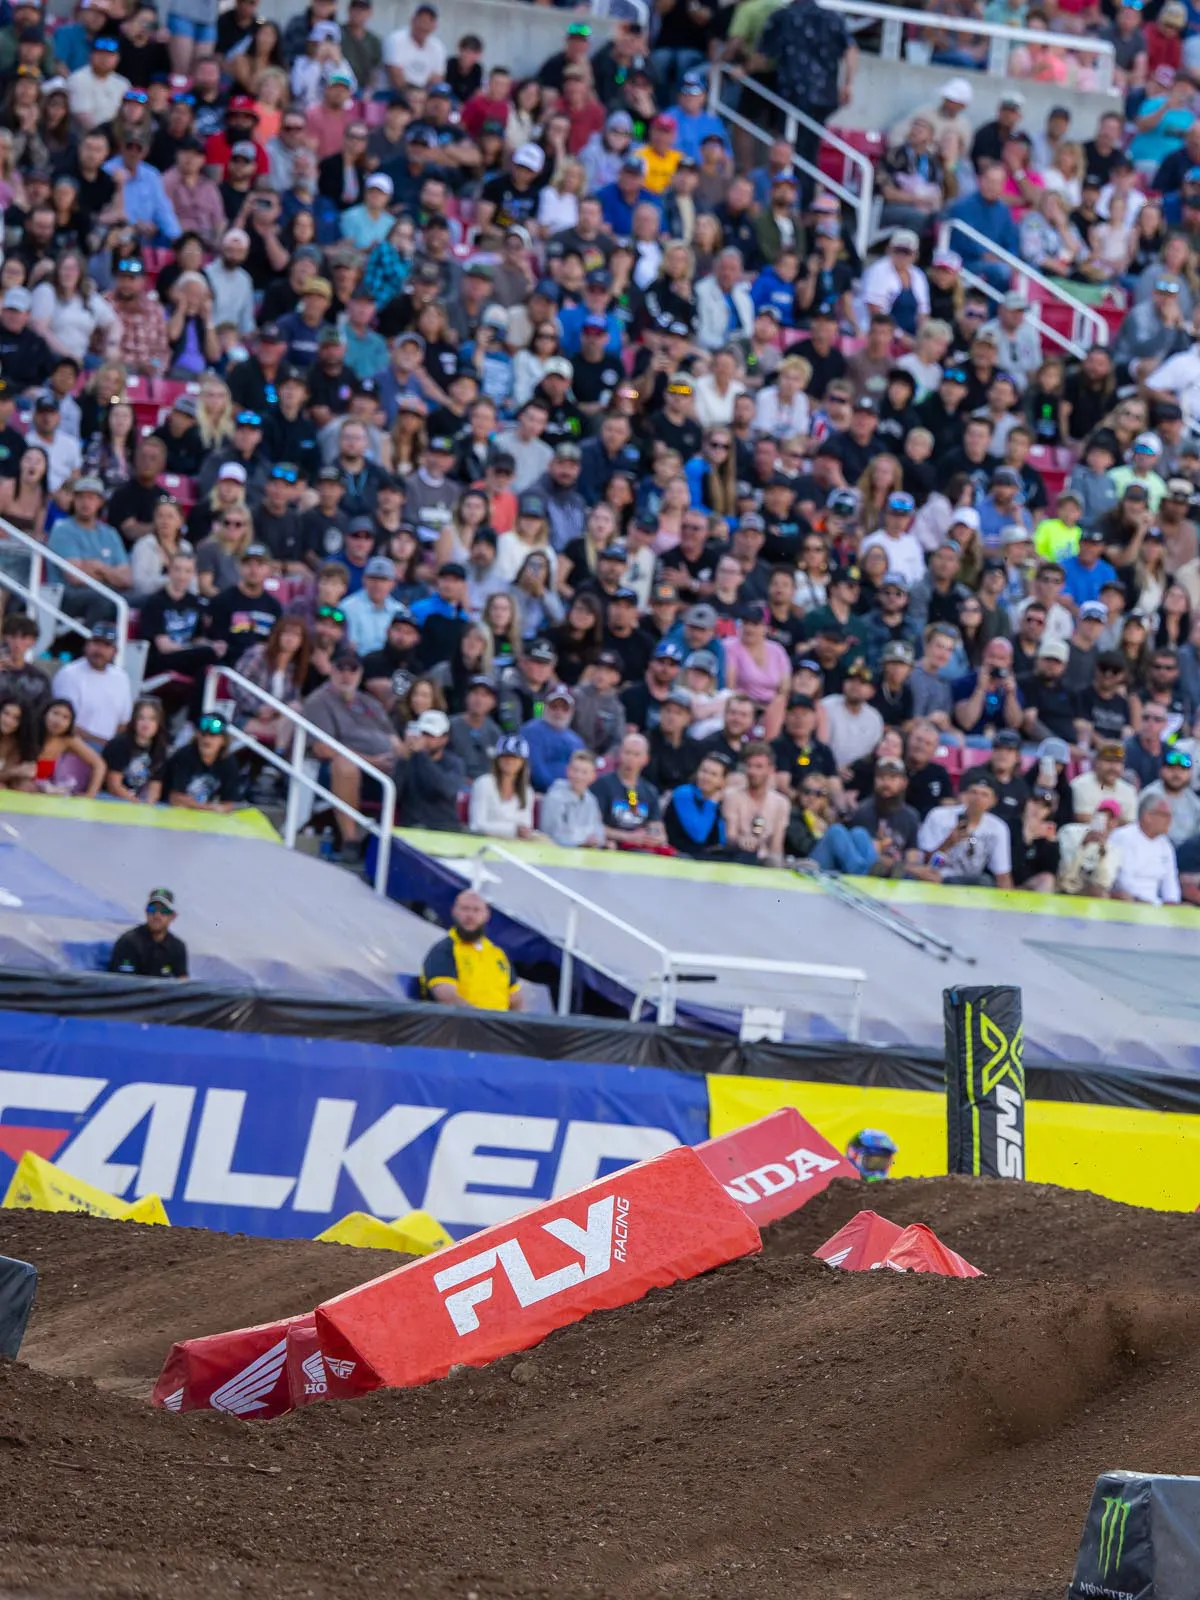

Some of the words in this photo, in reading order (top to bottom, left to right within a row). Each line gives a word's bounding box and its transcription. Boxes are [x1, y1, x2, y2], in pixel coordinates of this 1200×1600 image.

[721, 1148, 840, 1204] NDA
[613, 1196, 630, 1263] RACING
[433, 1194, 615, 1337] FLY
